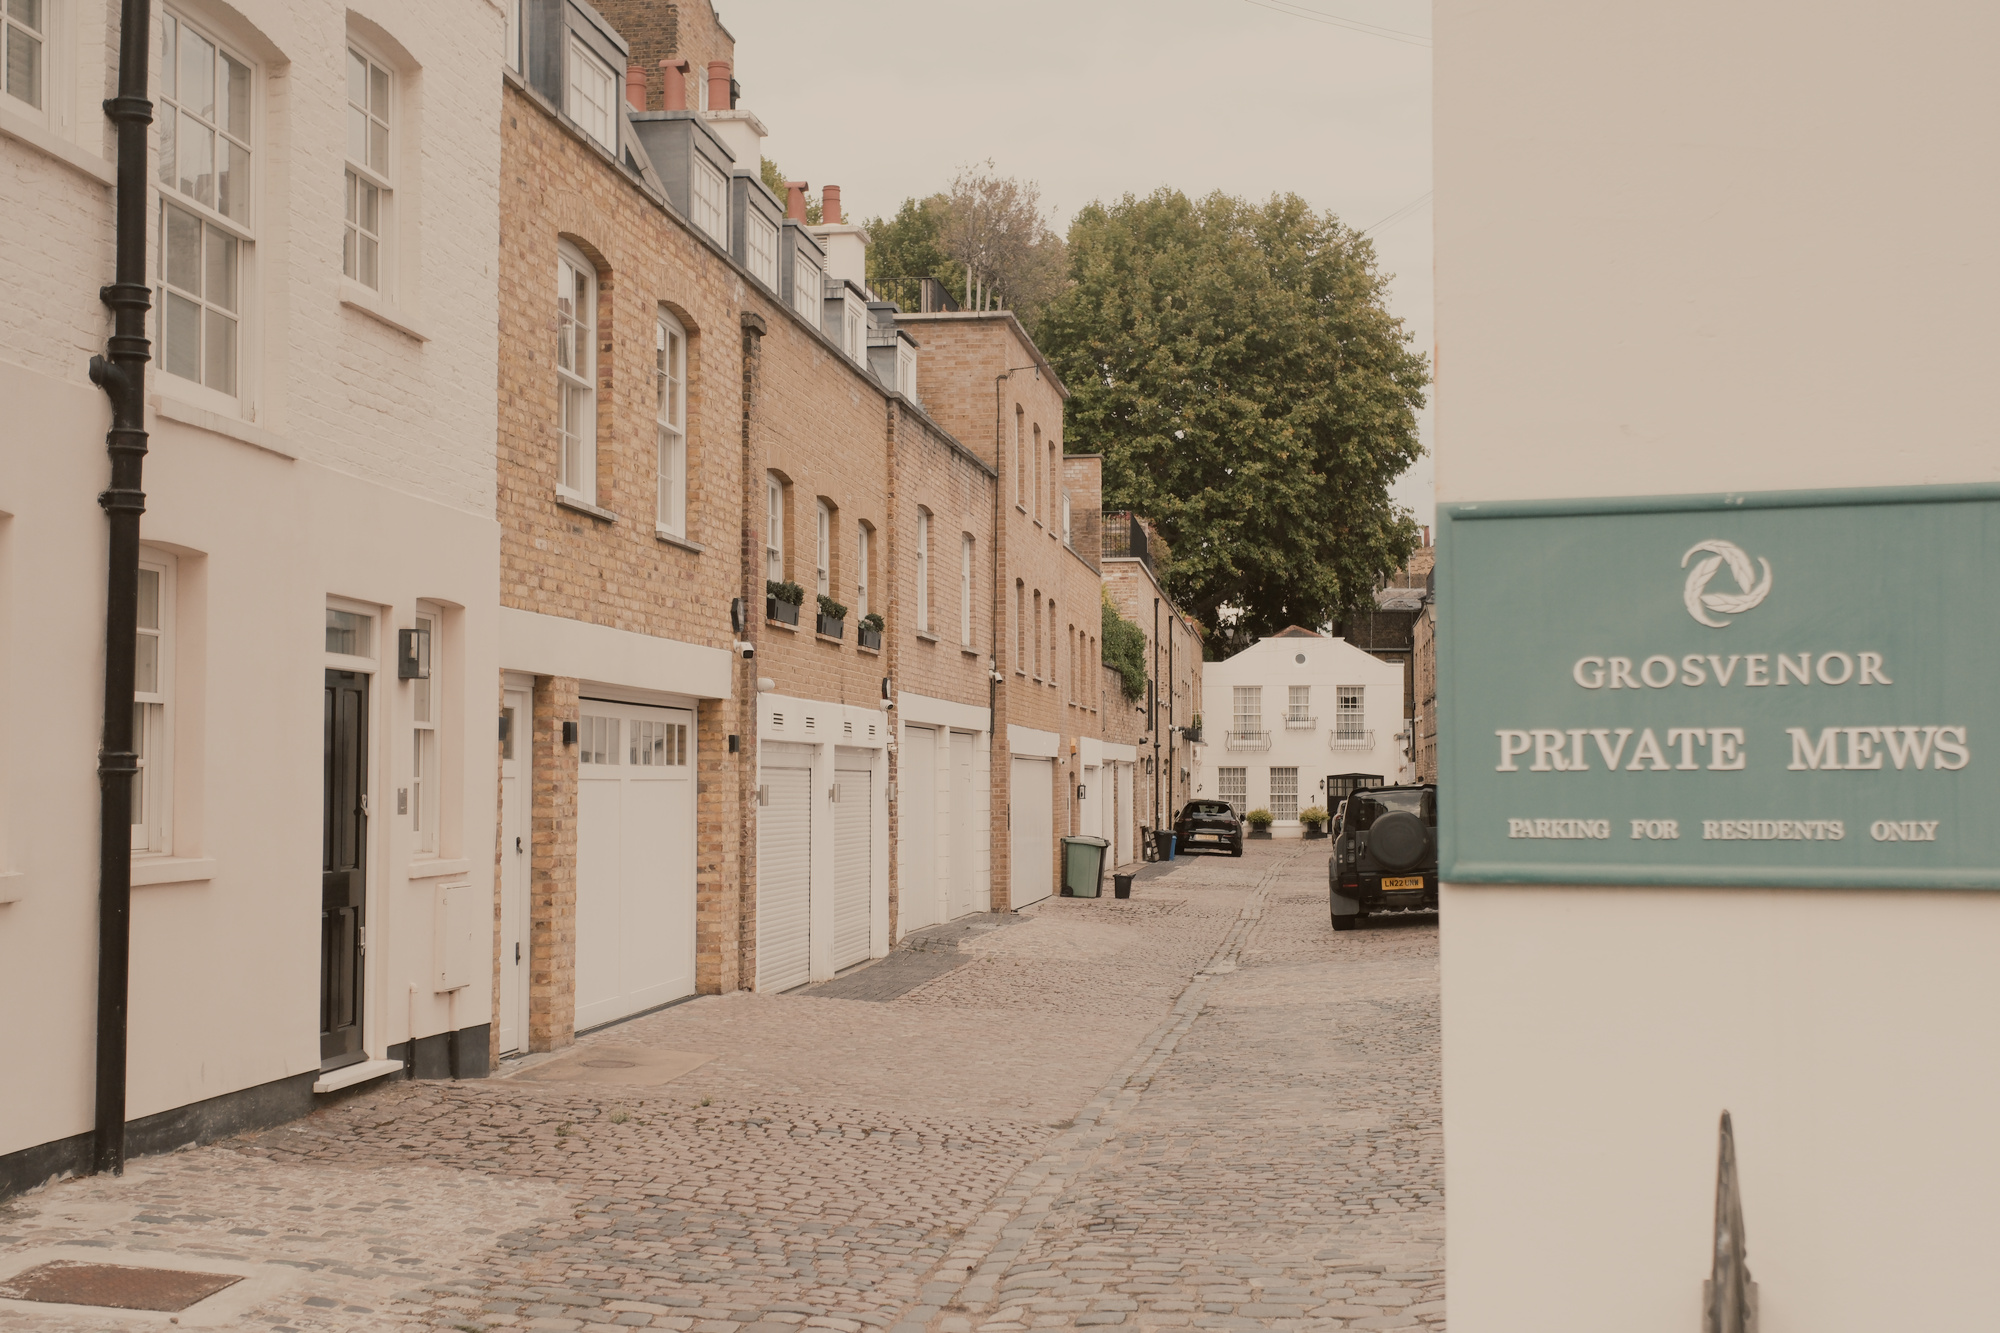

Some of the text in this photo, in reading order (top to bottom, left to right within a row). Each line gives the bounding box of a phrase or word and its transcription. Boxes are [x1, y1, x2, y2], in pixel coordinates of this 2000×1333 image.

[1572, 652, 1892, 689] GROSVENOR
[1495, 726, 1970, 772] PRIVATE MEWS
[1508, 818, 1939, 842] PARKING FOR RESIDENTS ONLY
[1384, 879, 1404, 888] LN22
